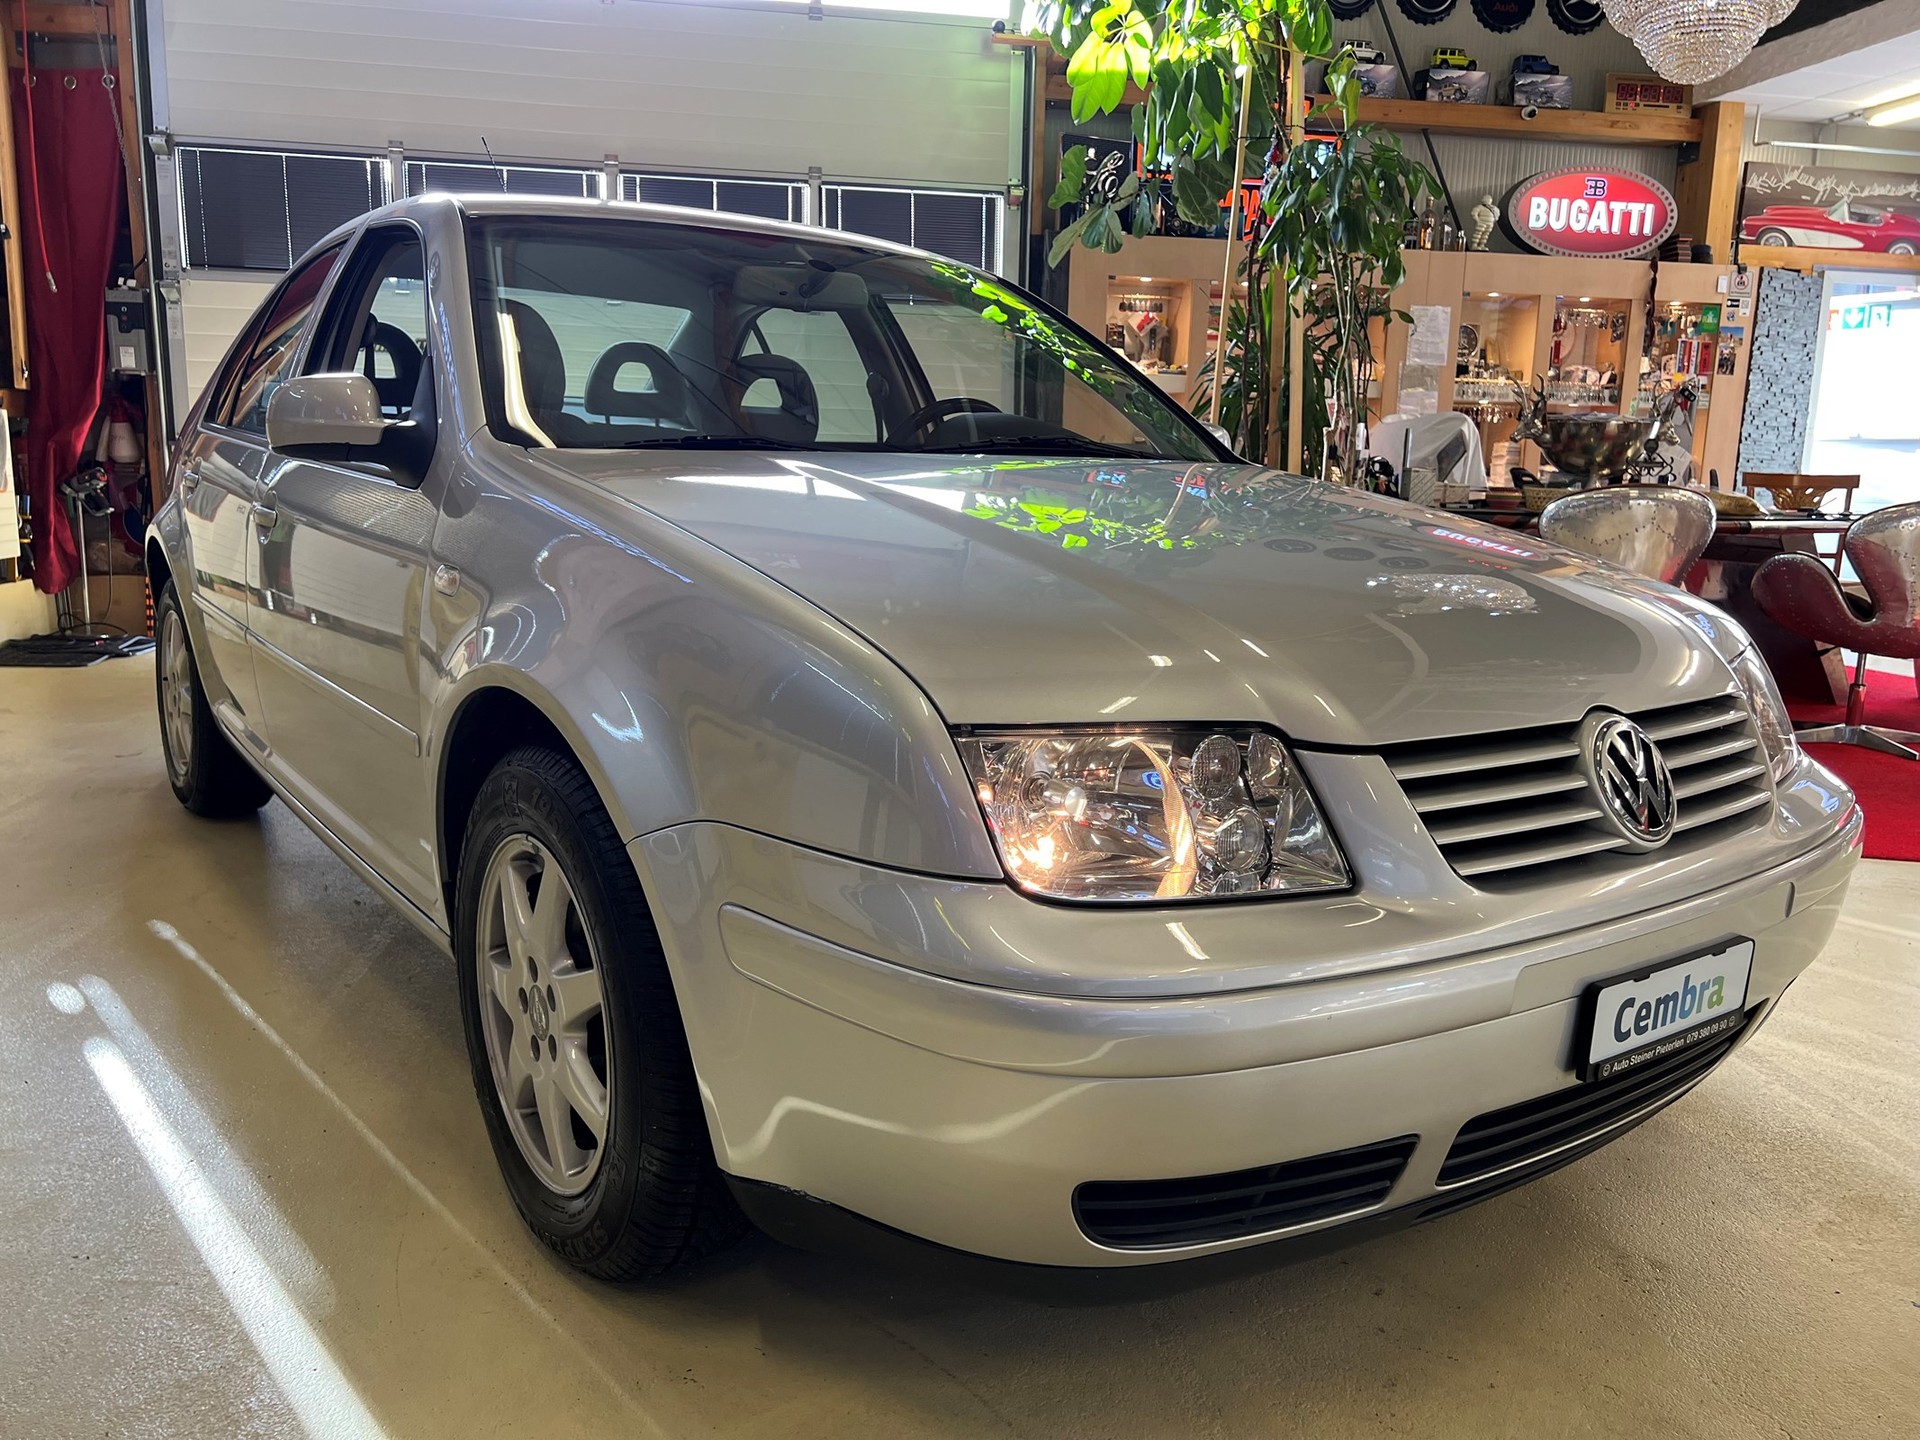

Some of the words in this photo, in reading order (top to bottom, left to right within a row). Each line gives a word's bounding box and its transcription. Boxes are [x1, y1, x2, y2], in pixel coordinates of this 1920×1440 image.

[1493, 2, 1519, 13] Audi
[1528, 196, 1655, 236] BUGATTI
[1613, 974, 1725, 1043] Cembra
[1612, 1060, 1629, 1072] Auto
[1630, 1050, 1655, 1065] Steiner
